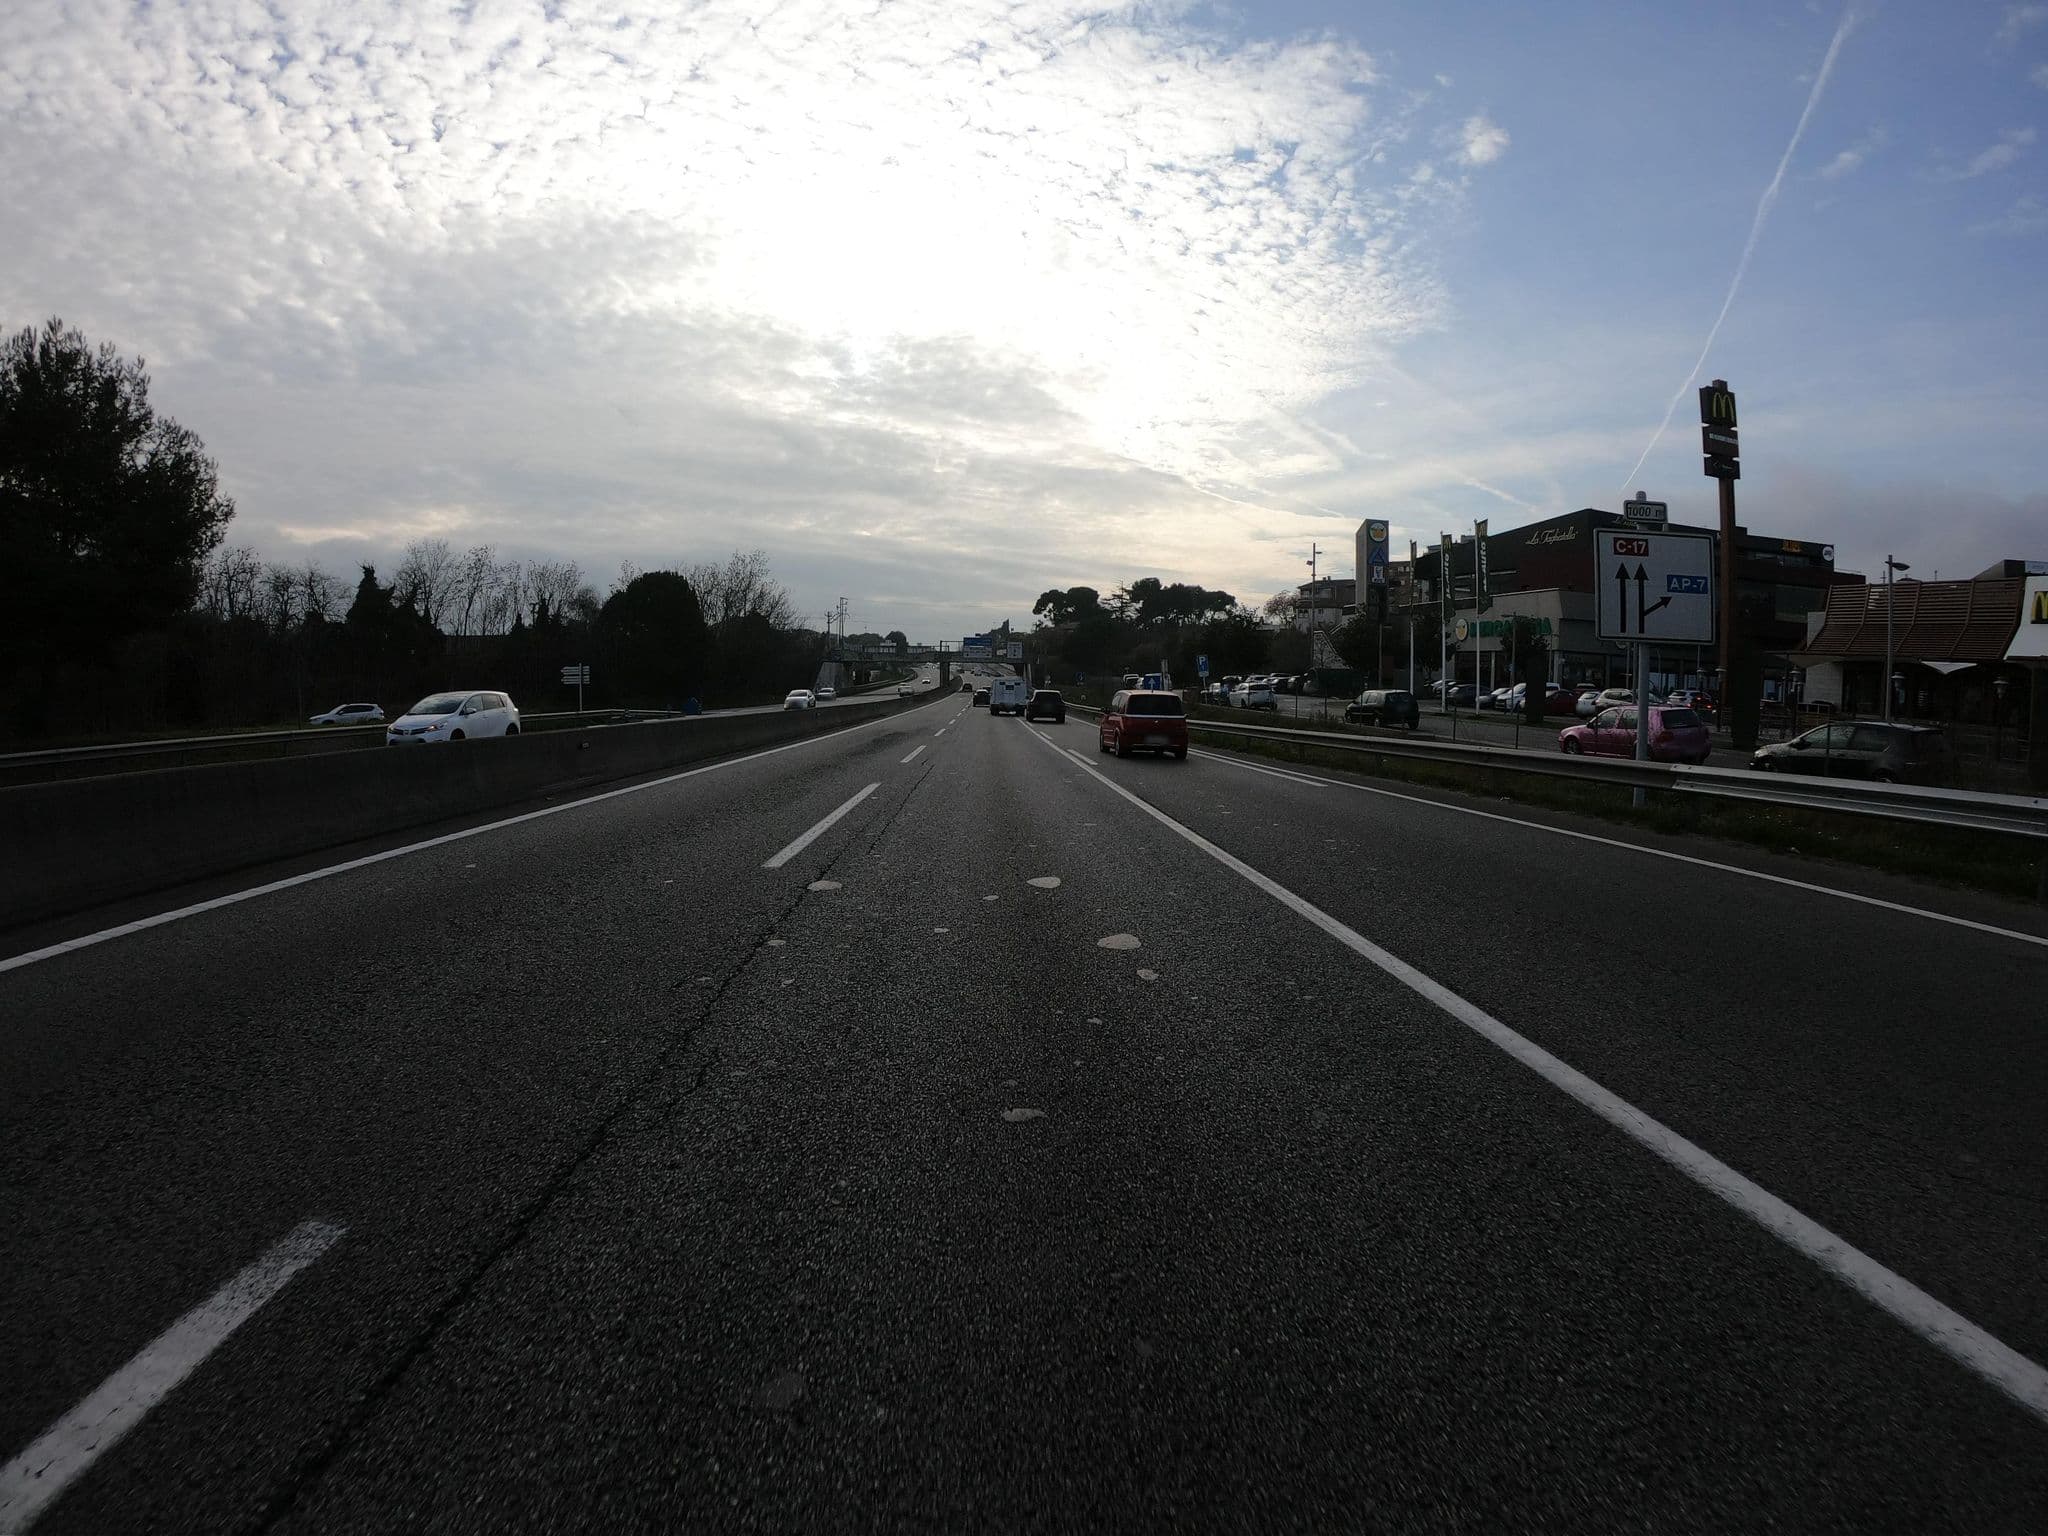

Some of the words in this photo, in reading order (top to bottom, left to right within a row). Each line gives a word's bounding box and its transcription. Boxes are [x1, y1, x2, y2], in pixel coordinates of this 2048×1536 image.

[1628, 506, 1651, 517] 1000
[1615, 539, 1647, 554] C-17
[1670, 577, 1705, 591] AP-7
